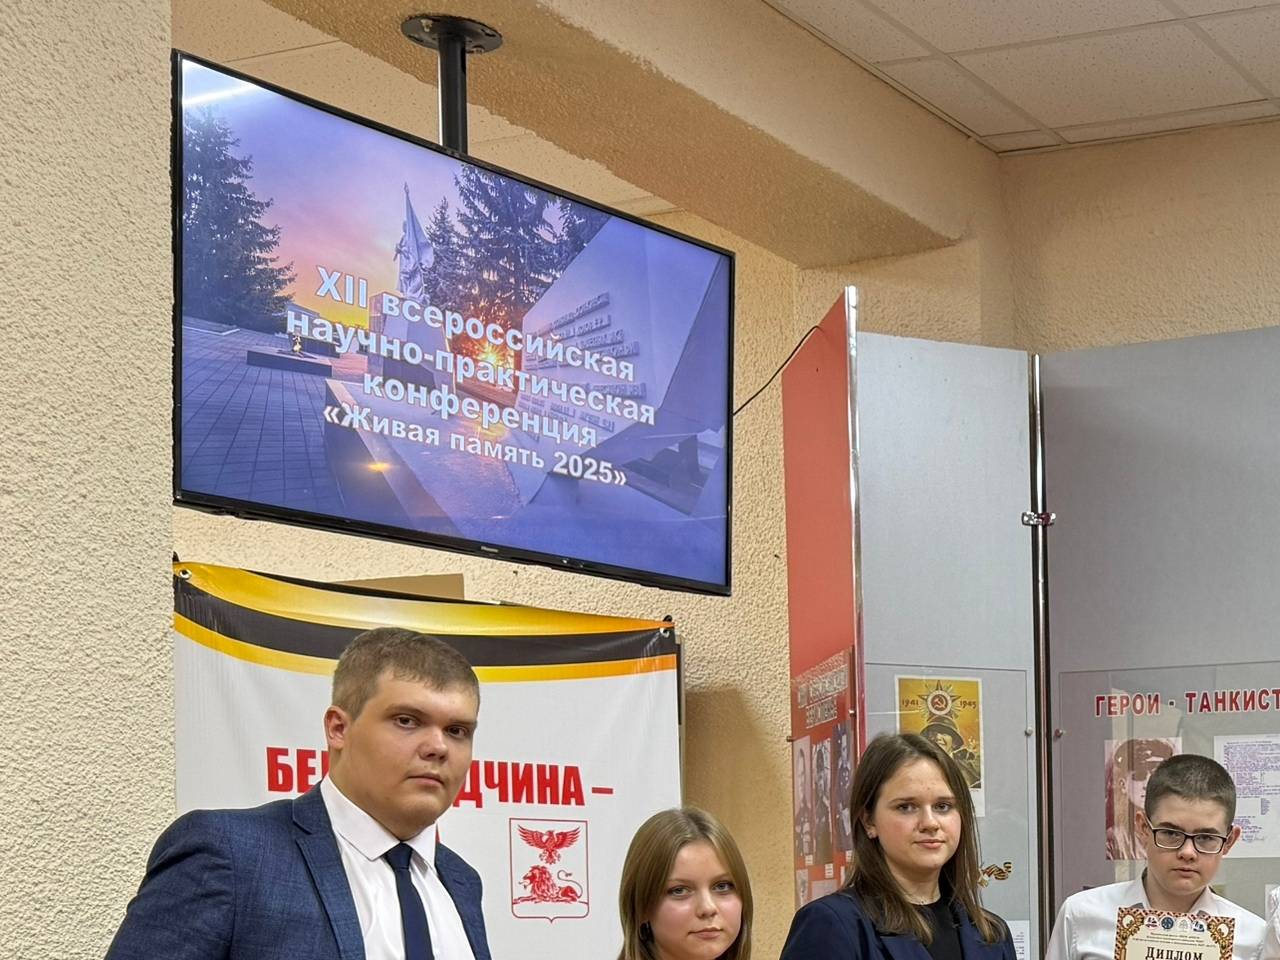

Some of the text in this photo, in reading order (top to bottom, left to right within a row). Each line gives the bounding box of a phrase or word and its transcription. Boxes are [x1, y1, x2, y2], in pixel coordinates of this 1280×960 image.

[316, 265, 368, 309] XII
[382, 292, 635, 382] всероссийская
[286, 310, 655, 426] научно-практическая
[322, 402, 628, 488] «Живая память 2025»
[364, 373, 598, 448] конференция
[1095, 693, 1161, 717] ГЕРОИ
[266, 747, 585, 808] БЕДЧИНА
